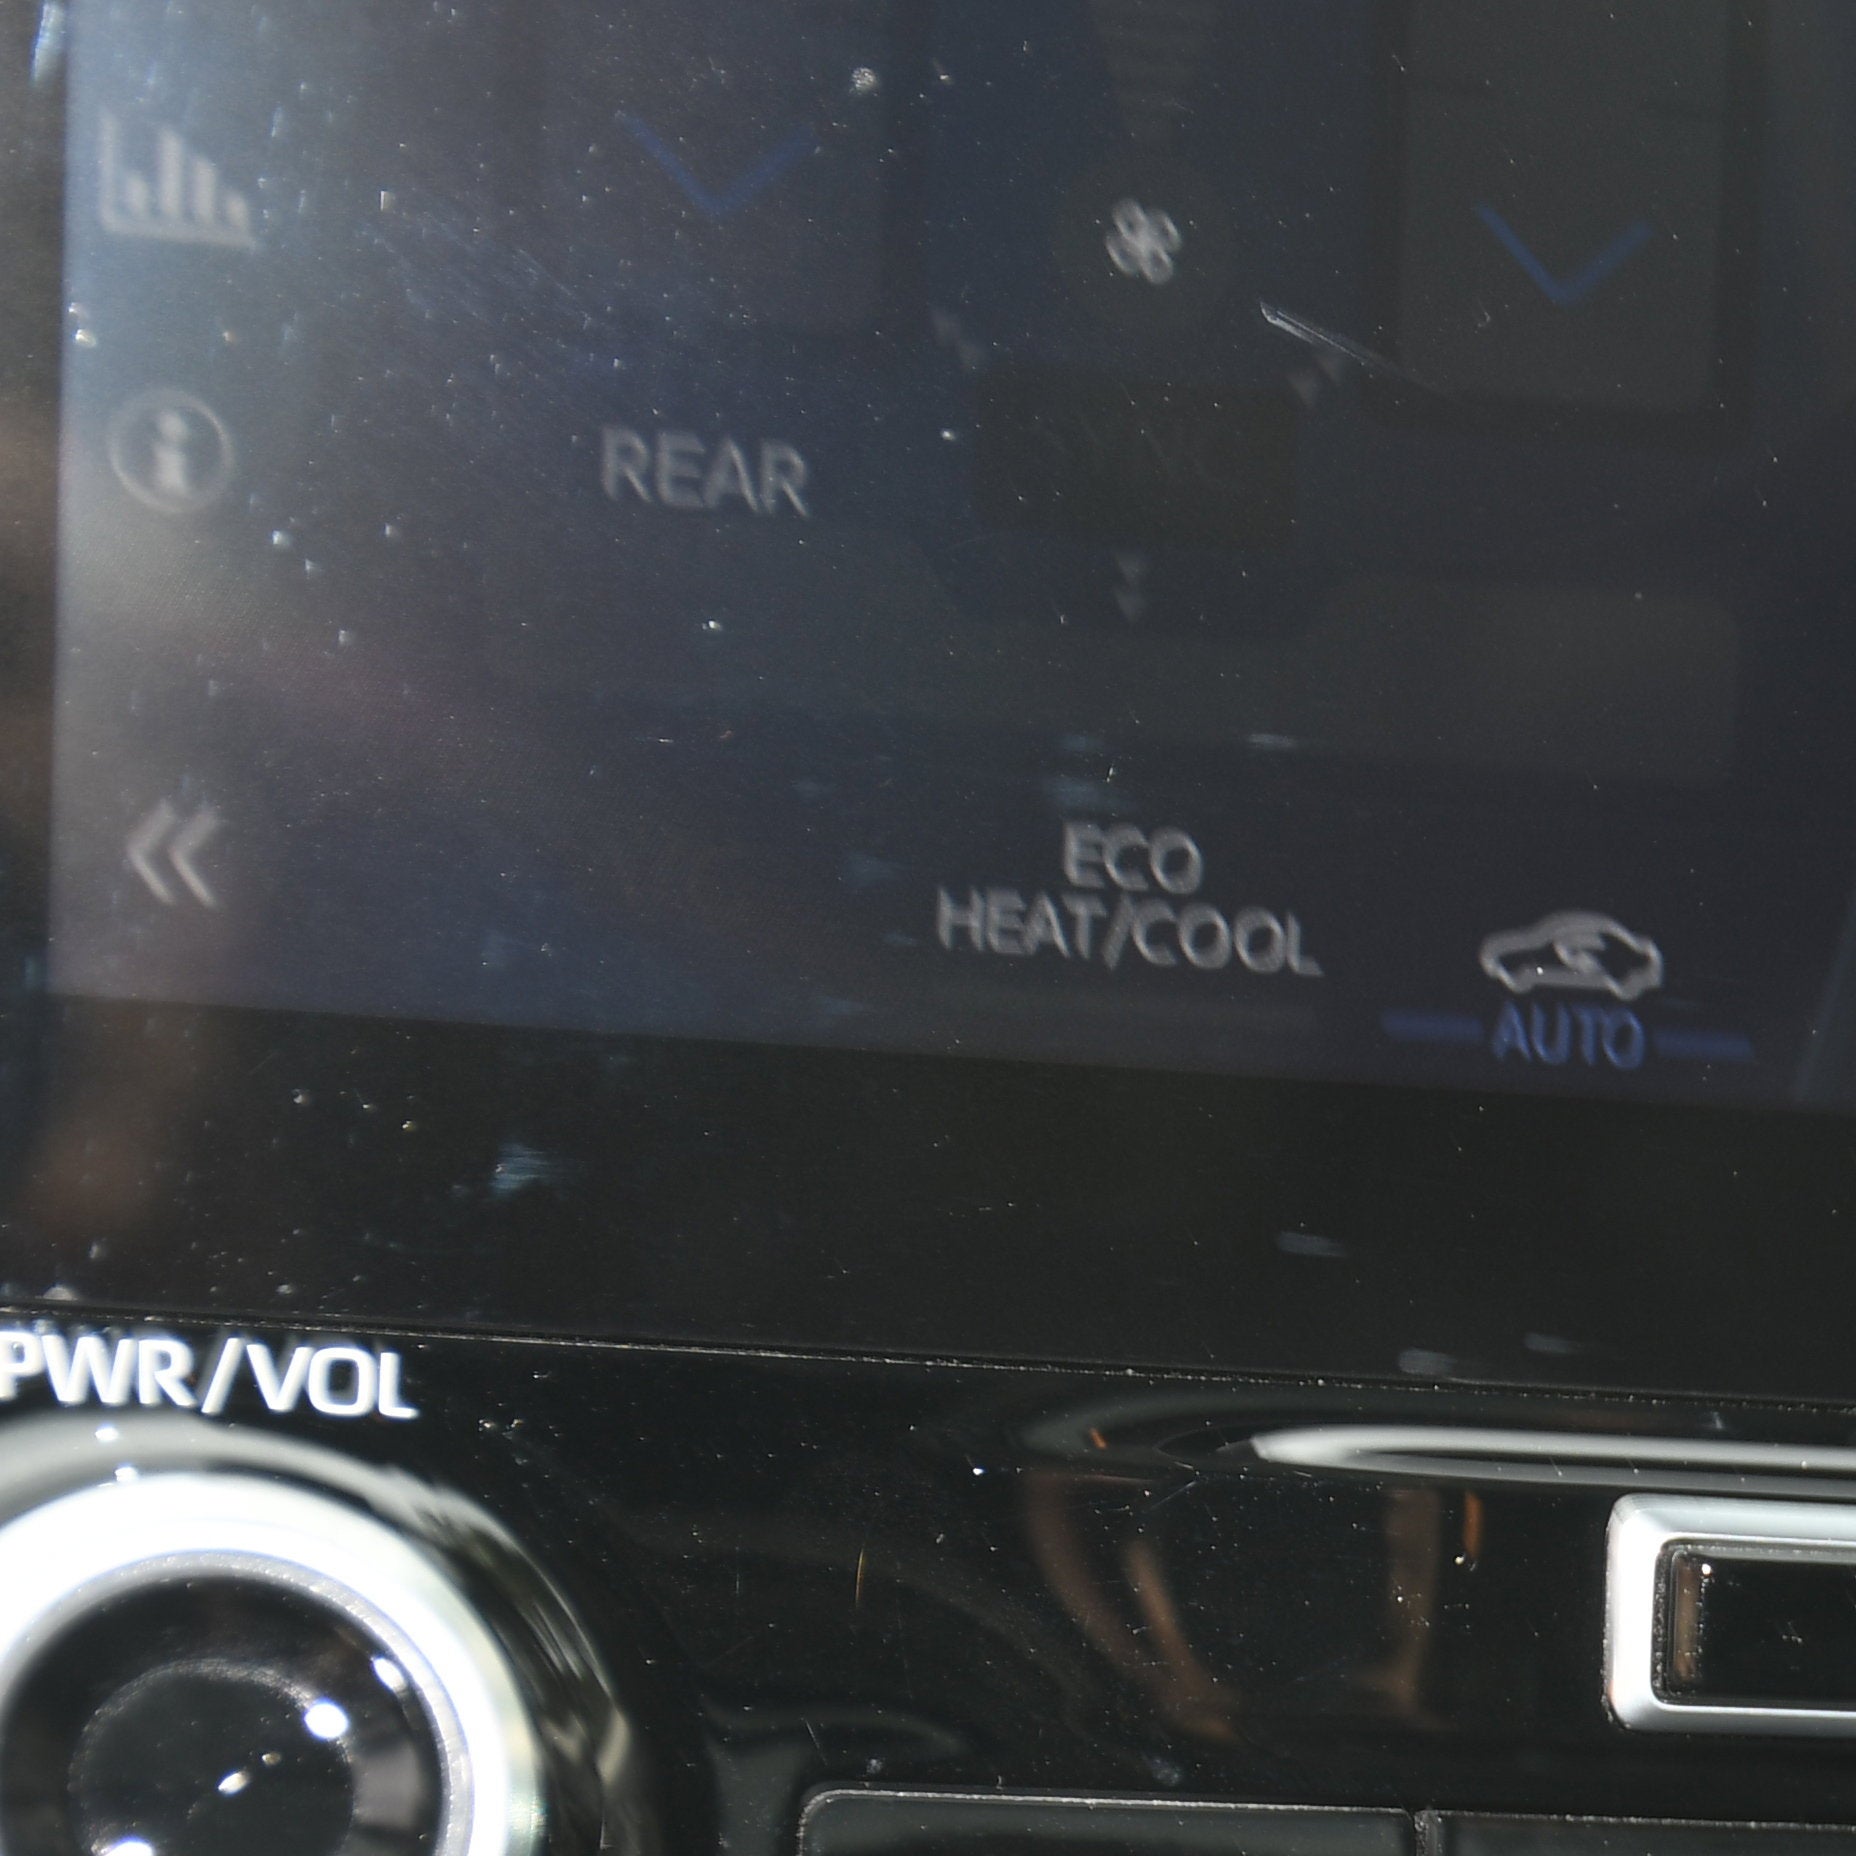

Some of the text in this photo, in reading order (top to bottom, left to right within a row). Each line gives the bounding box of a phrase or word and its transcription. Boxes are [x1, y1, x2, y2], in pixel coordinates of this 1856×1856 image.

[600, 424, 808, 516] REAR
[1062, 822, 1204, 894] ECO
[936, 886, 1323, 977] HEAT/COOL
[1493, 1002, 1646, 1070] AUTO
[0, 1330, 420, 1420] PWR/VOL
